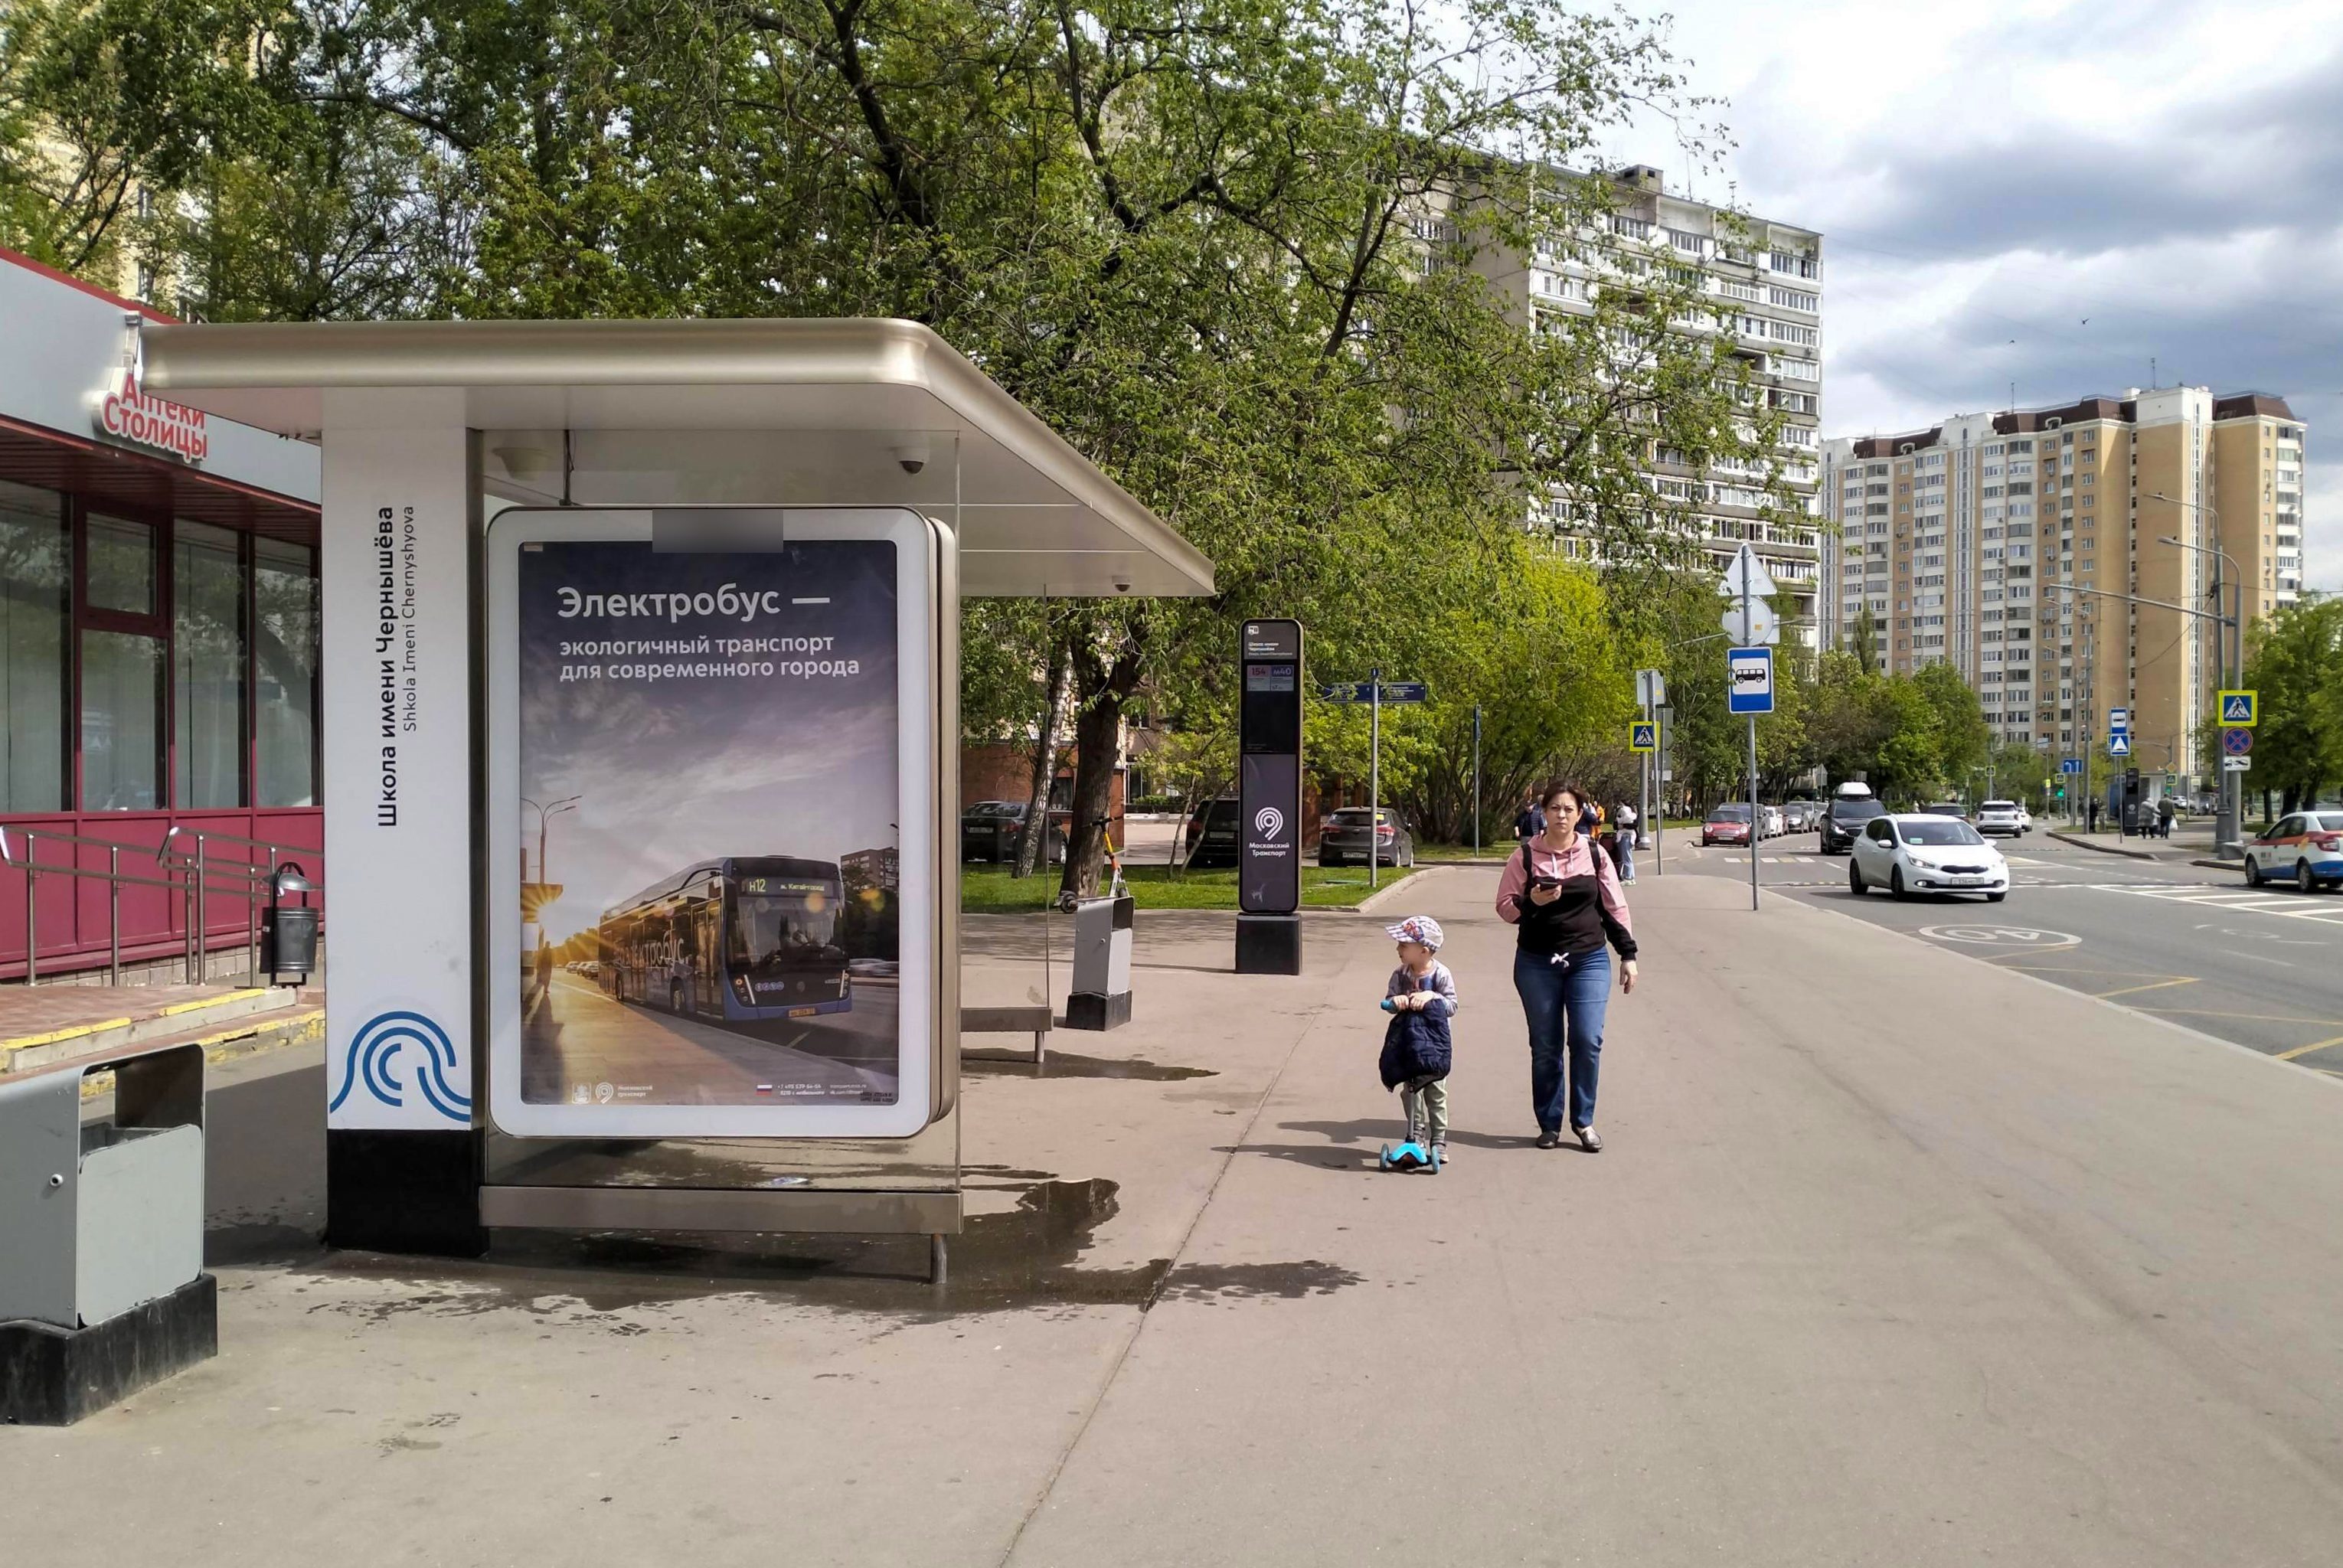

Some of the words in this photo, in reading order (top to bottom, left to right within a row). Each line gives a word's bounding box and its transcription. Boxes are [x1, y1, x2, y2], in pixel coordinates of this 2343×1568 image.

[104, 395, 208, 459] Столицы
[374, 507, 398, 652] Чернышёва
[400, 506, 417, 619] Chernyshyova
[557, 583, 781, 623] Электробус
[402, 625, 416, 672] Imeni
[560, 635, 710, 656] экологичный
[715, 634, 834, 657] транспорт
[560, 662, 601, 682] для
[608, 660, 774, 682] современного
[780, 658, 859, 678] города
[381, 660, 396, 737] имени
[403, 678, 417, 731] Shkola
[377, 746, 397, 826] Школа
